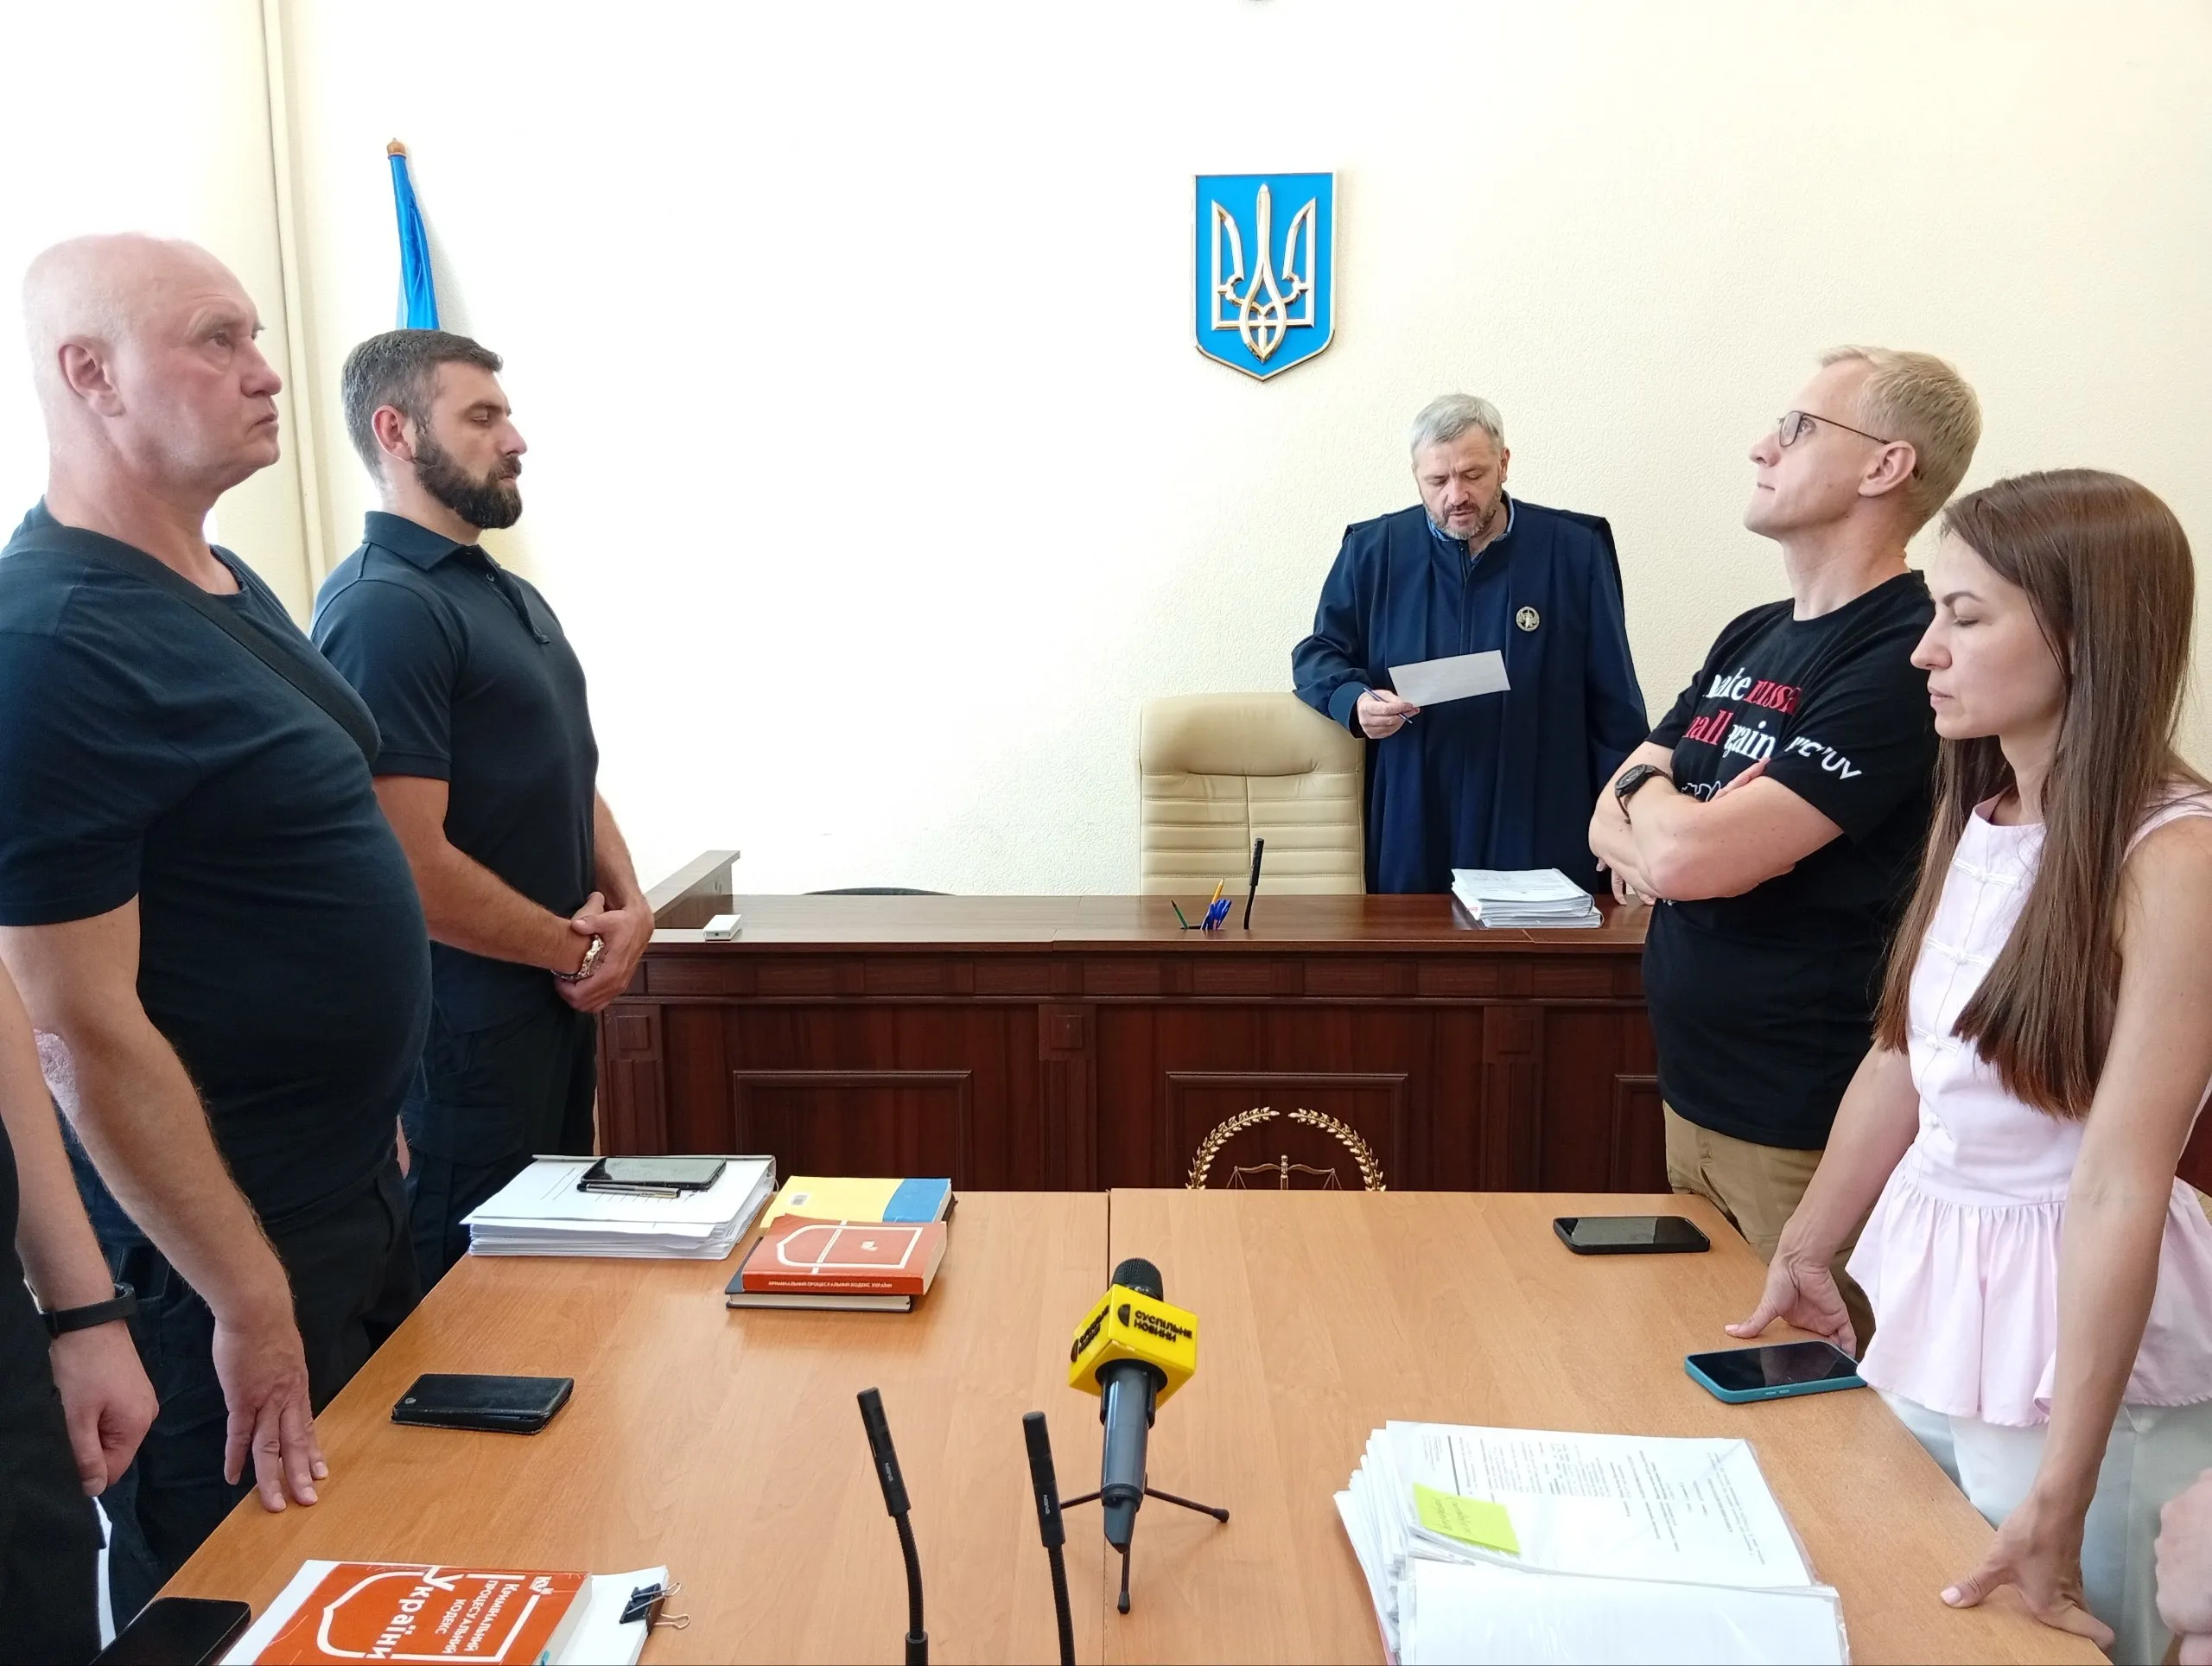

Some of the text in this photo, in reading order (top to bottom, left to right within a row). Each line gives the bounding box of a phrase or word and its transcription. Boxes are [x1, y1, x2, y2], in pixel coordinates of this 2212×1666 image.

[1134, 1319, 1176, 1342] НОВИНИ
[365, 1566, 465, 1659] України
[435, 1599, 467, 1635] КОДЕКС
